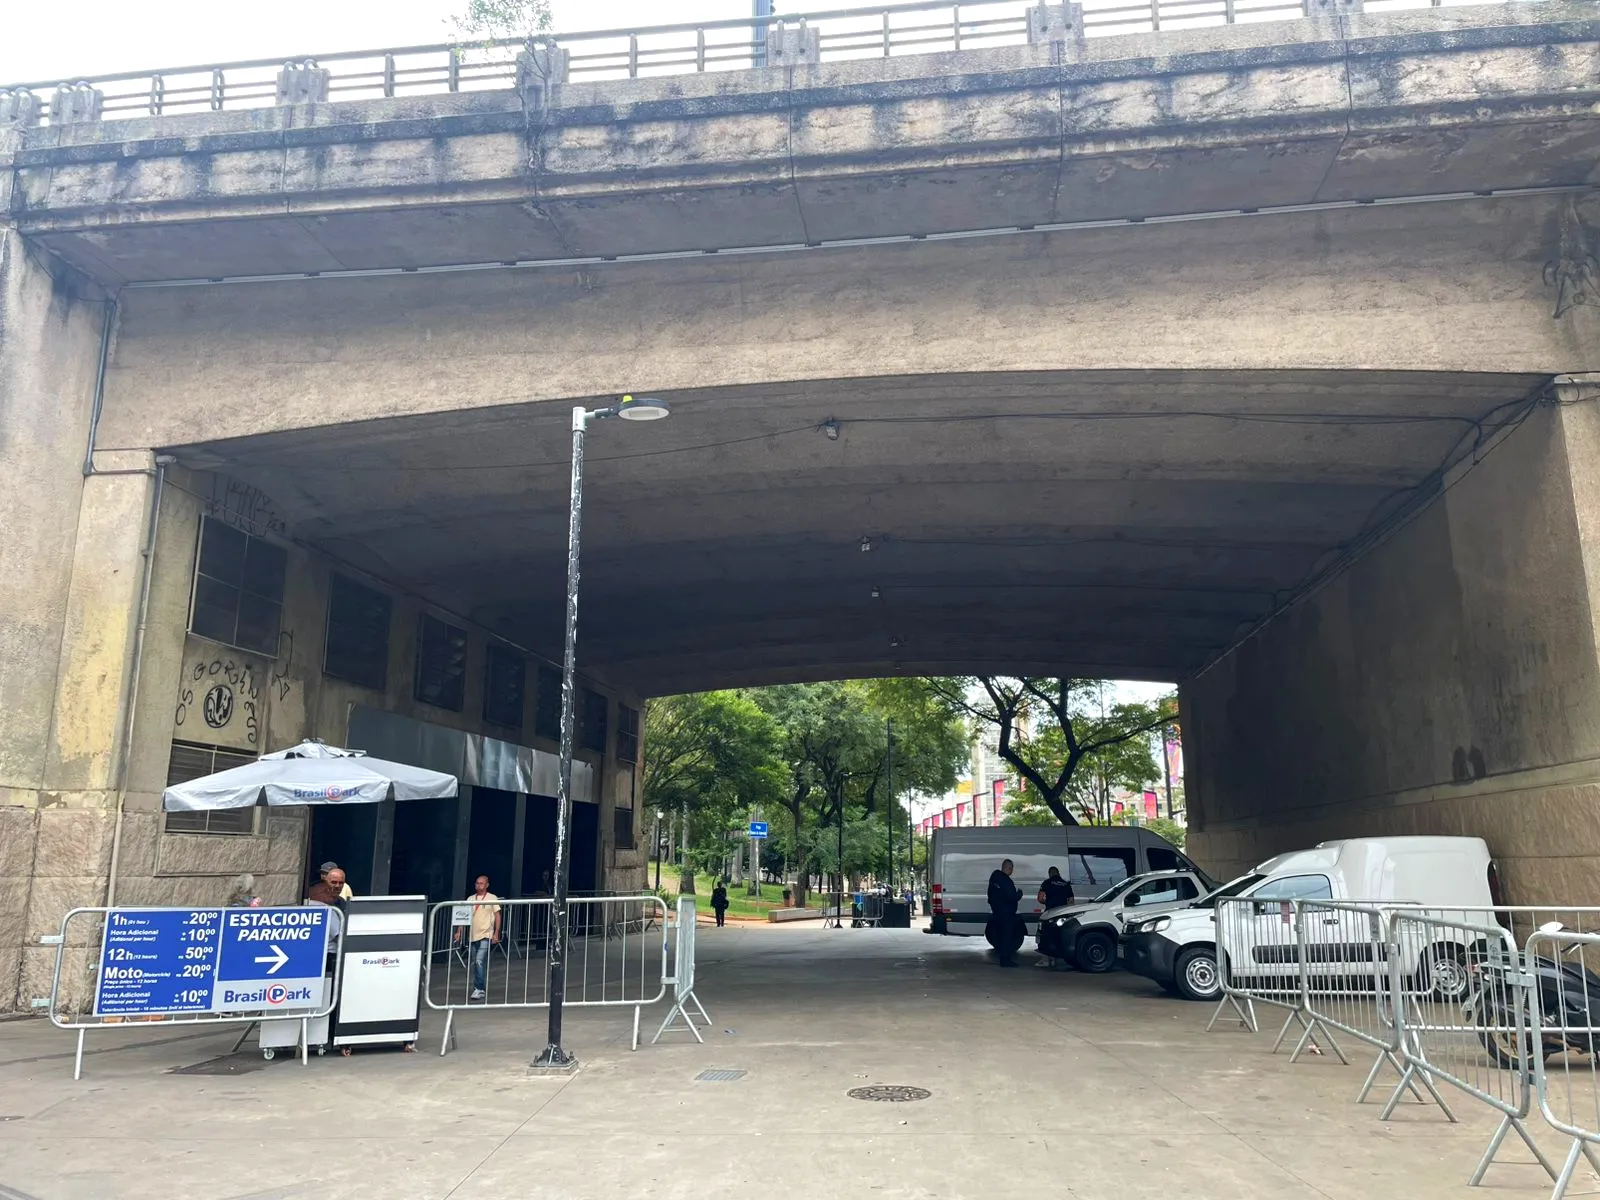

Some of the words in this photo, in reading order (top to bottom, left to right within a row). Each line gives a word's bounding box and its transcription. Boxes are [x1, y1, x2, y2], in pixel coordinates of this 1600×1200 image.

[229, 912, 323, 927] ESTACIONE
[237, 927, 312, 942] PARKING
[104, 966, 143, 979] Moto
